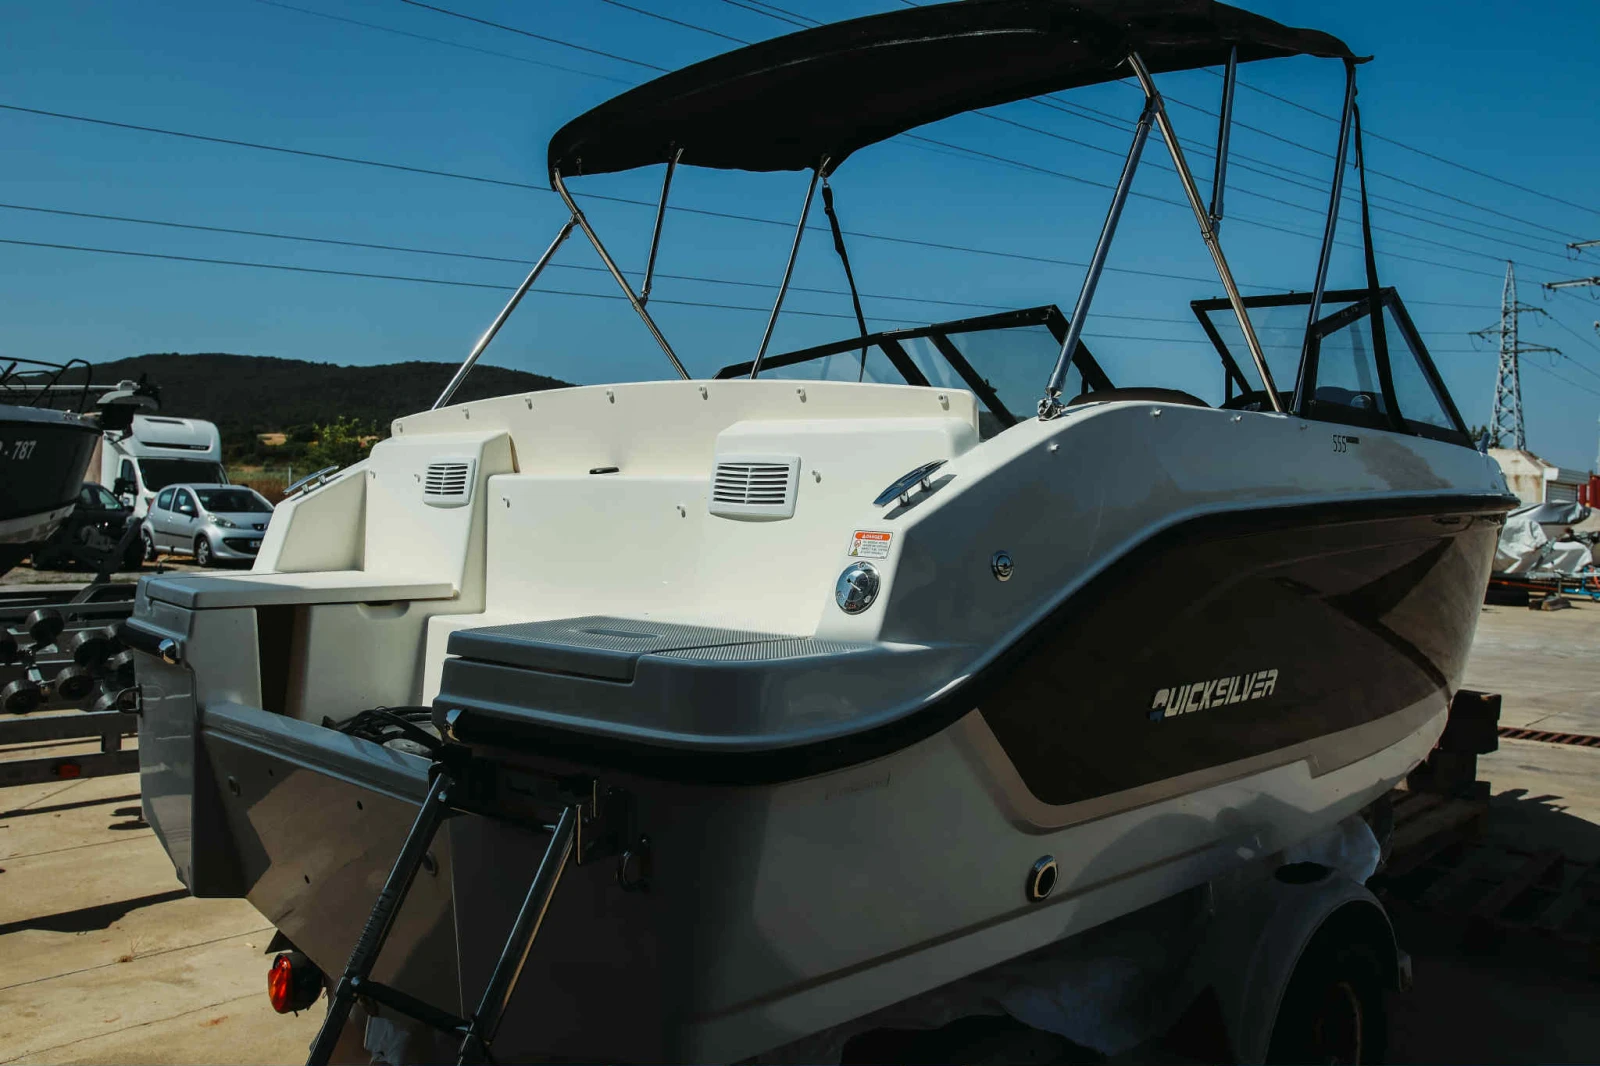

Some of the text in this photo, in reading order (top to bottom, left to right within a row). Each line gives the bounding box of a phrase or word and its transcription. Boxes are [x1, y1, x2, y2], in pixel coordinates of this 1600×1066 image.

[12, 441, 37, 460] 787
[1333, 434, 1346, 453] 555
[1151, 669, 1279, 718] QUICKSILVER
